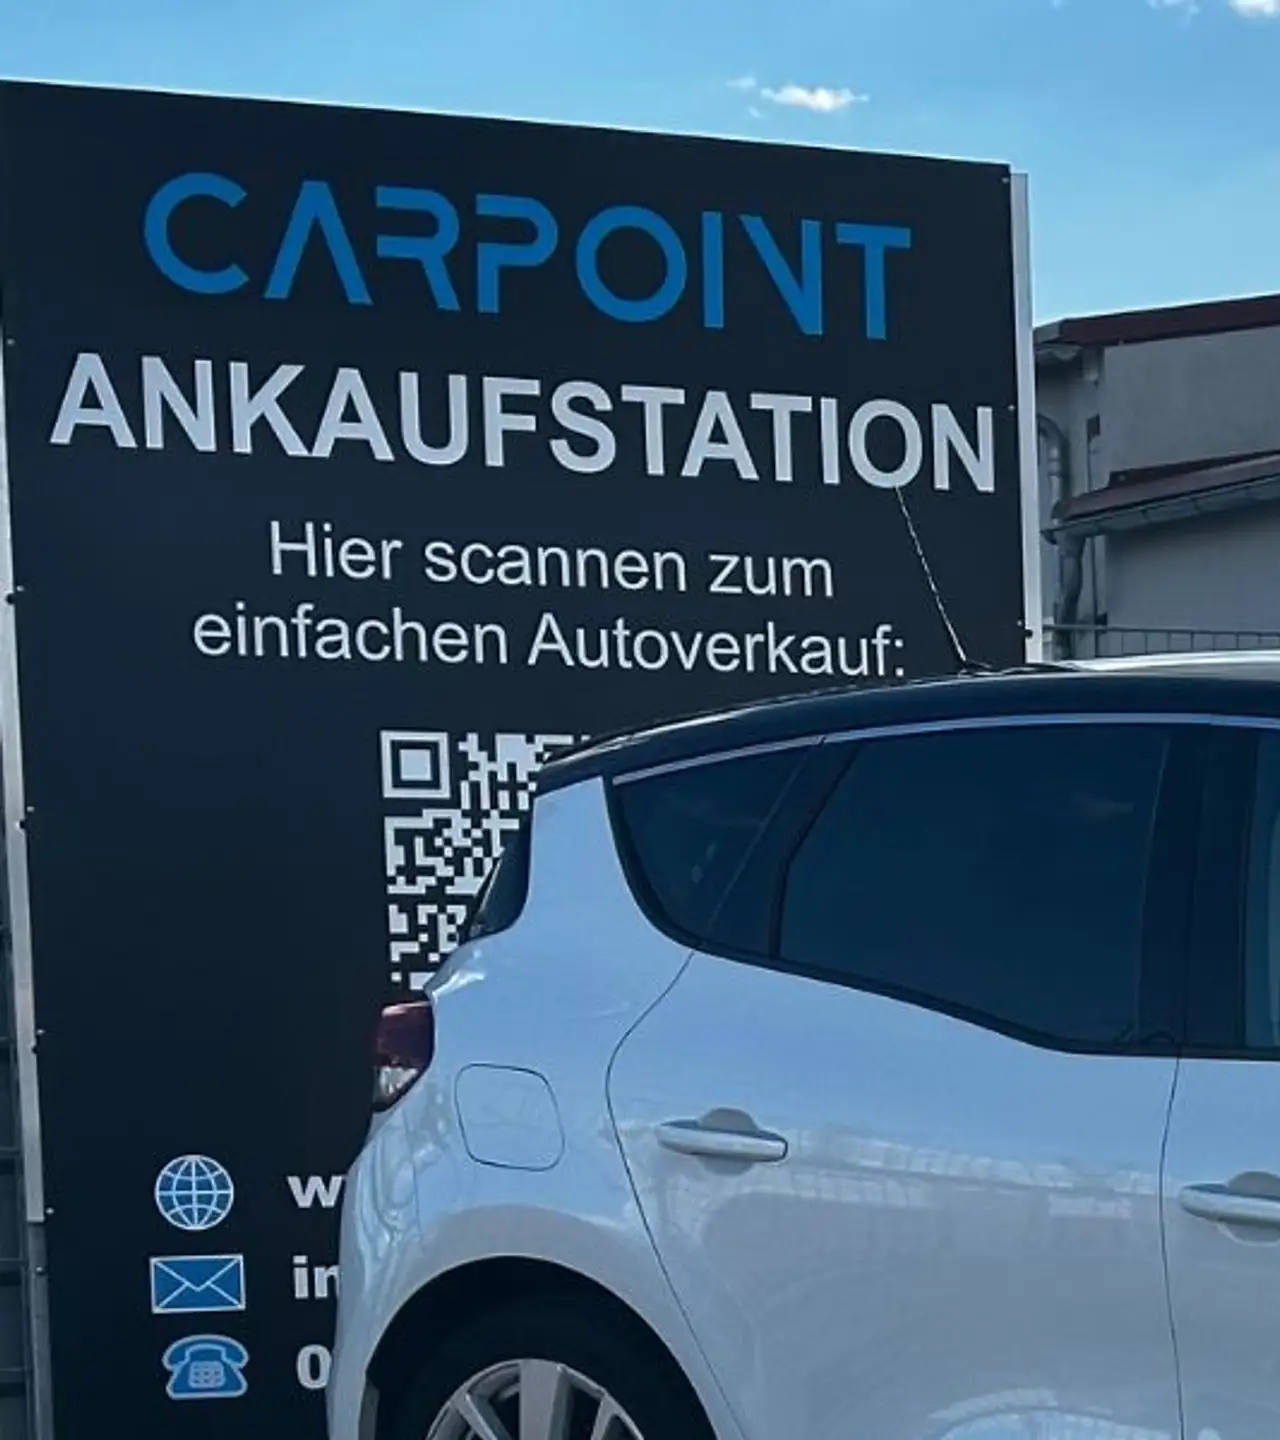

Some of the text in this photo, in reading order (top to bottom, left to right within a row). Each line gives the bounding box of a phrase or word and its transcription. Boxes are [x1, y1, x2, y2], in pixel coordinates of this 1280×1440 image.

[144, 171, 912, 341] CARPOINT
[50, 352, 996, 494] ANKAUFSTATION
[269, 520, 834, 598] Hier scannen zum
[192, 601, 907, 678] einfachen Autoverkauf:
